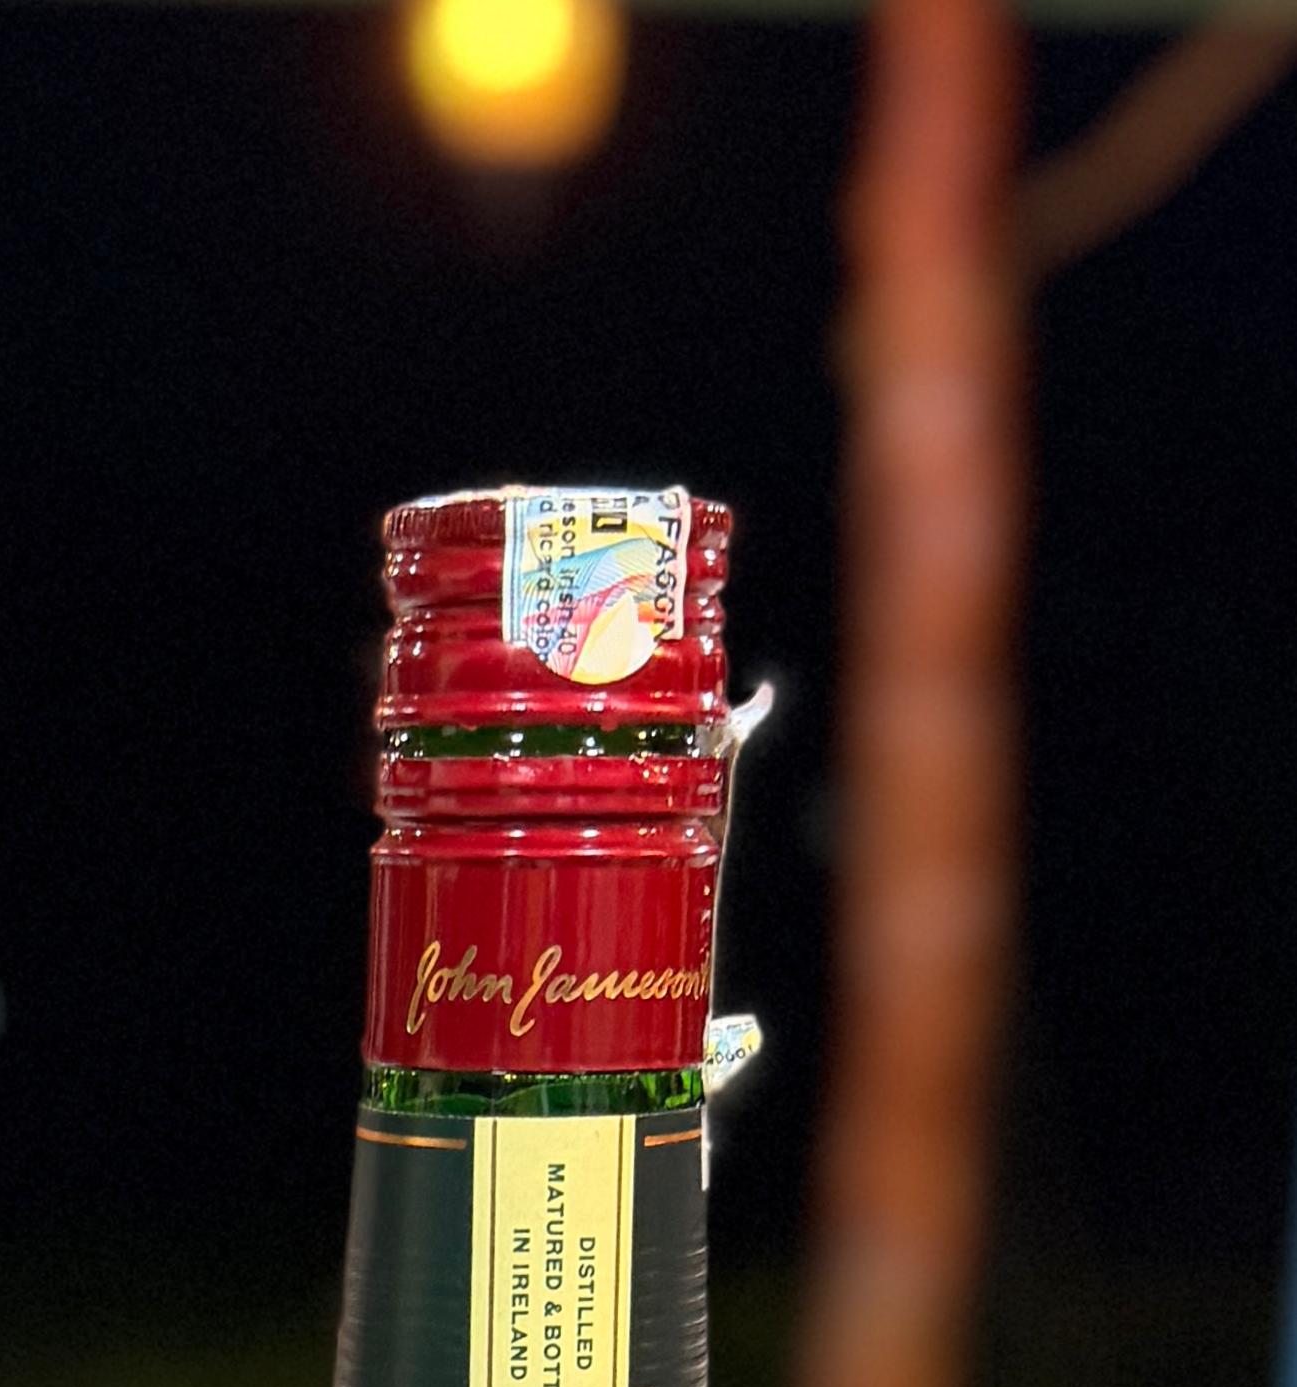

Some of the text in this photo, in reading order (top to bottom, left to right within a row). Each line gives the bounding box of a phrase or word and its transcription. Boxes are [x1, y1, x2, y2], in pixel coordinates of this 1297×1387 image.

[406, 940, 512, 1035] John
[545, 1163, 565, 1291] MATURED
[510, 1228, 531, 1381] IN IRELAND
[543, 1301, 563, 1316] &
[576, 1236, 596, 1371] DISTILLED
